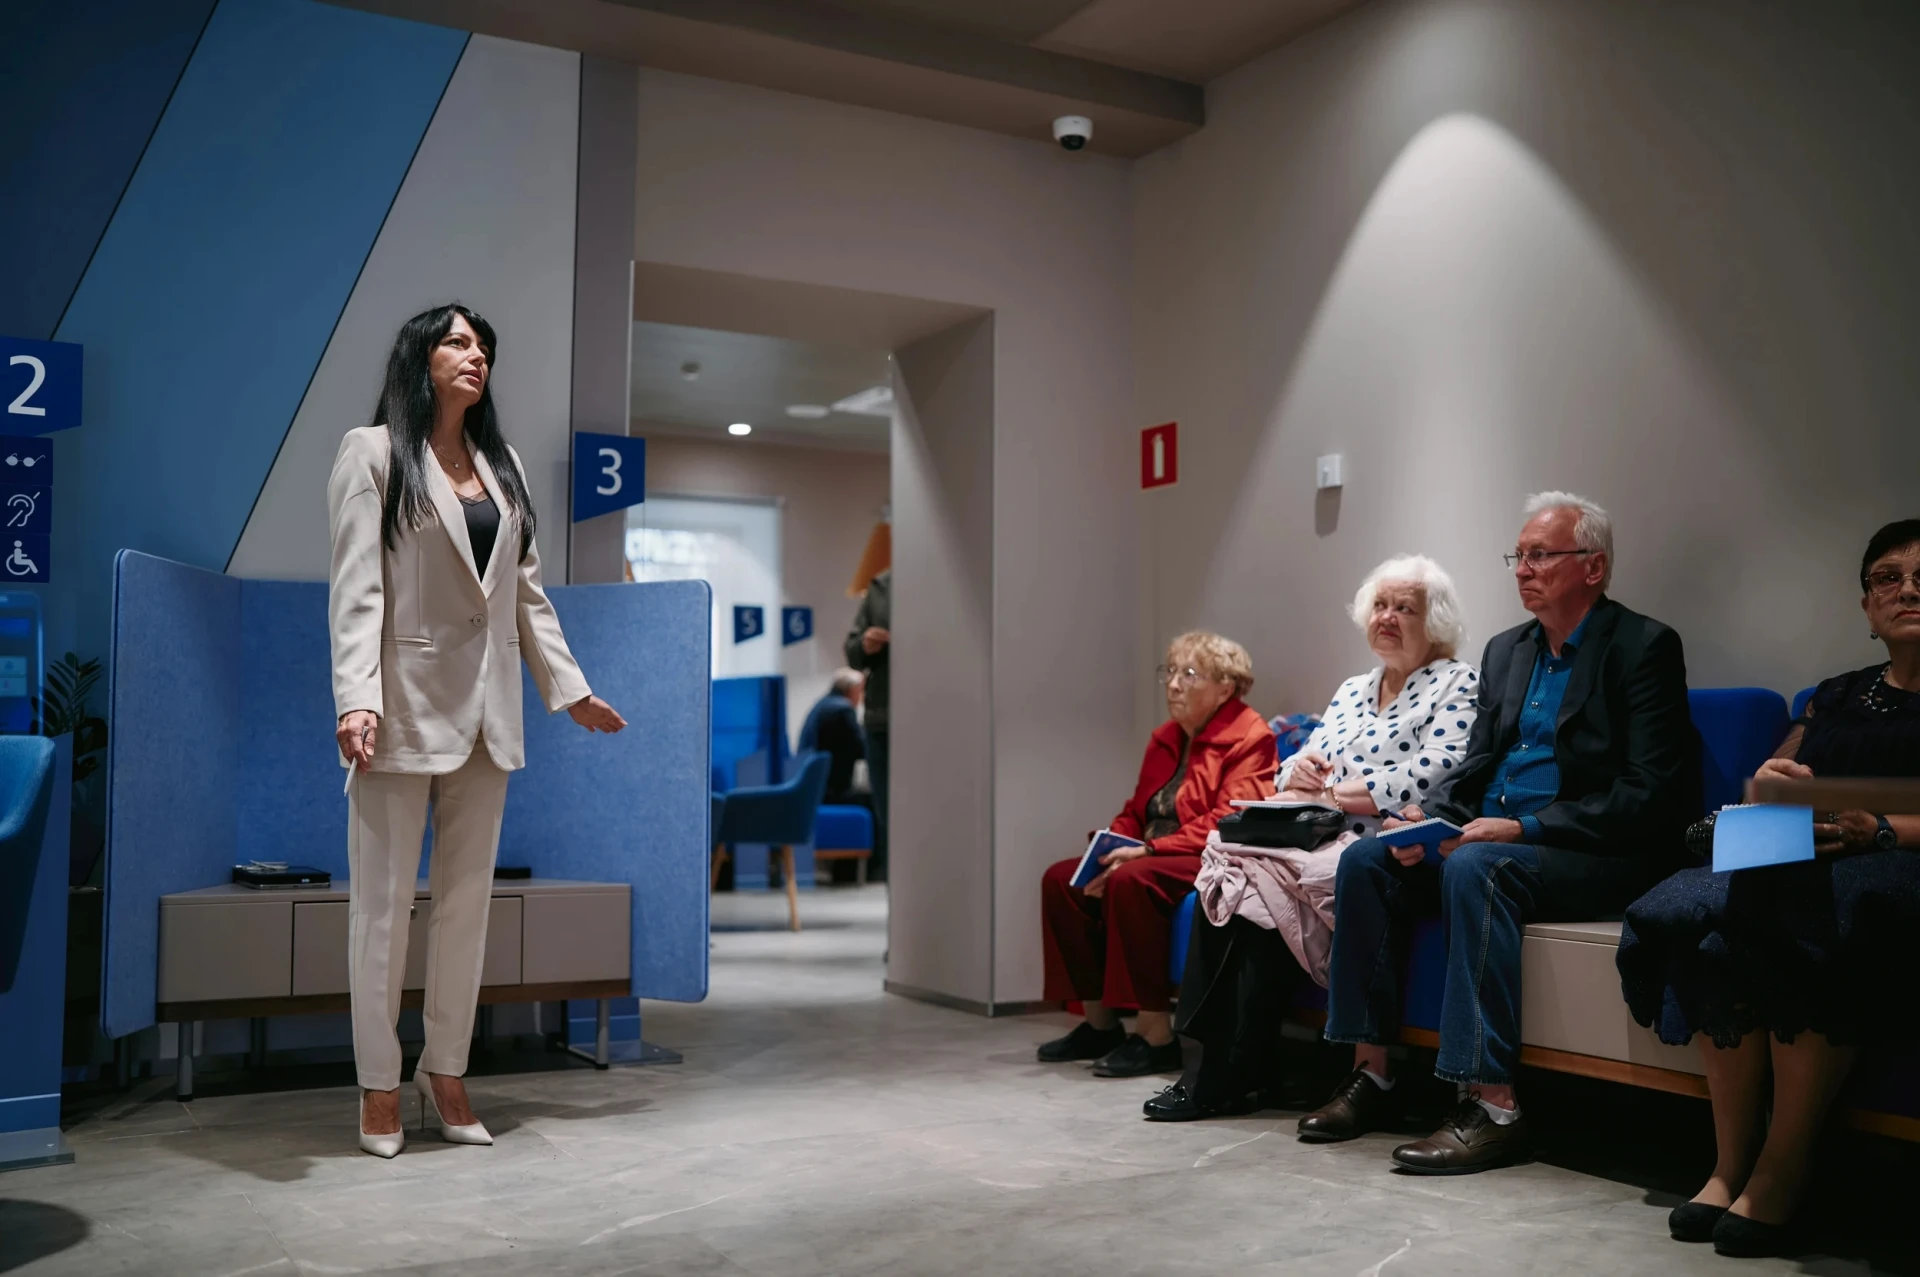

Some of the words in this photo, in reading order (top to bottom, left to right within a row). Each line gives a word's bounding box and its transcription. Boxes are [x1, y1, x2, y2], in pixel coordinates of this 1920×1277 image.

[8, 355, 46, 416] 2
[596, 448, 622, 496] 3
[740, 609, 757, 635] 5
[788, 610, 806, 637] 6
